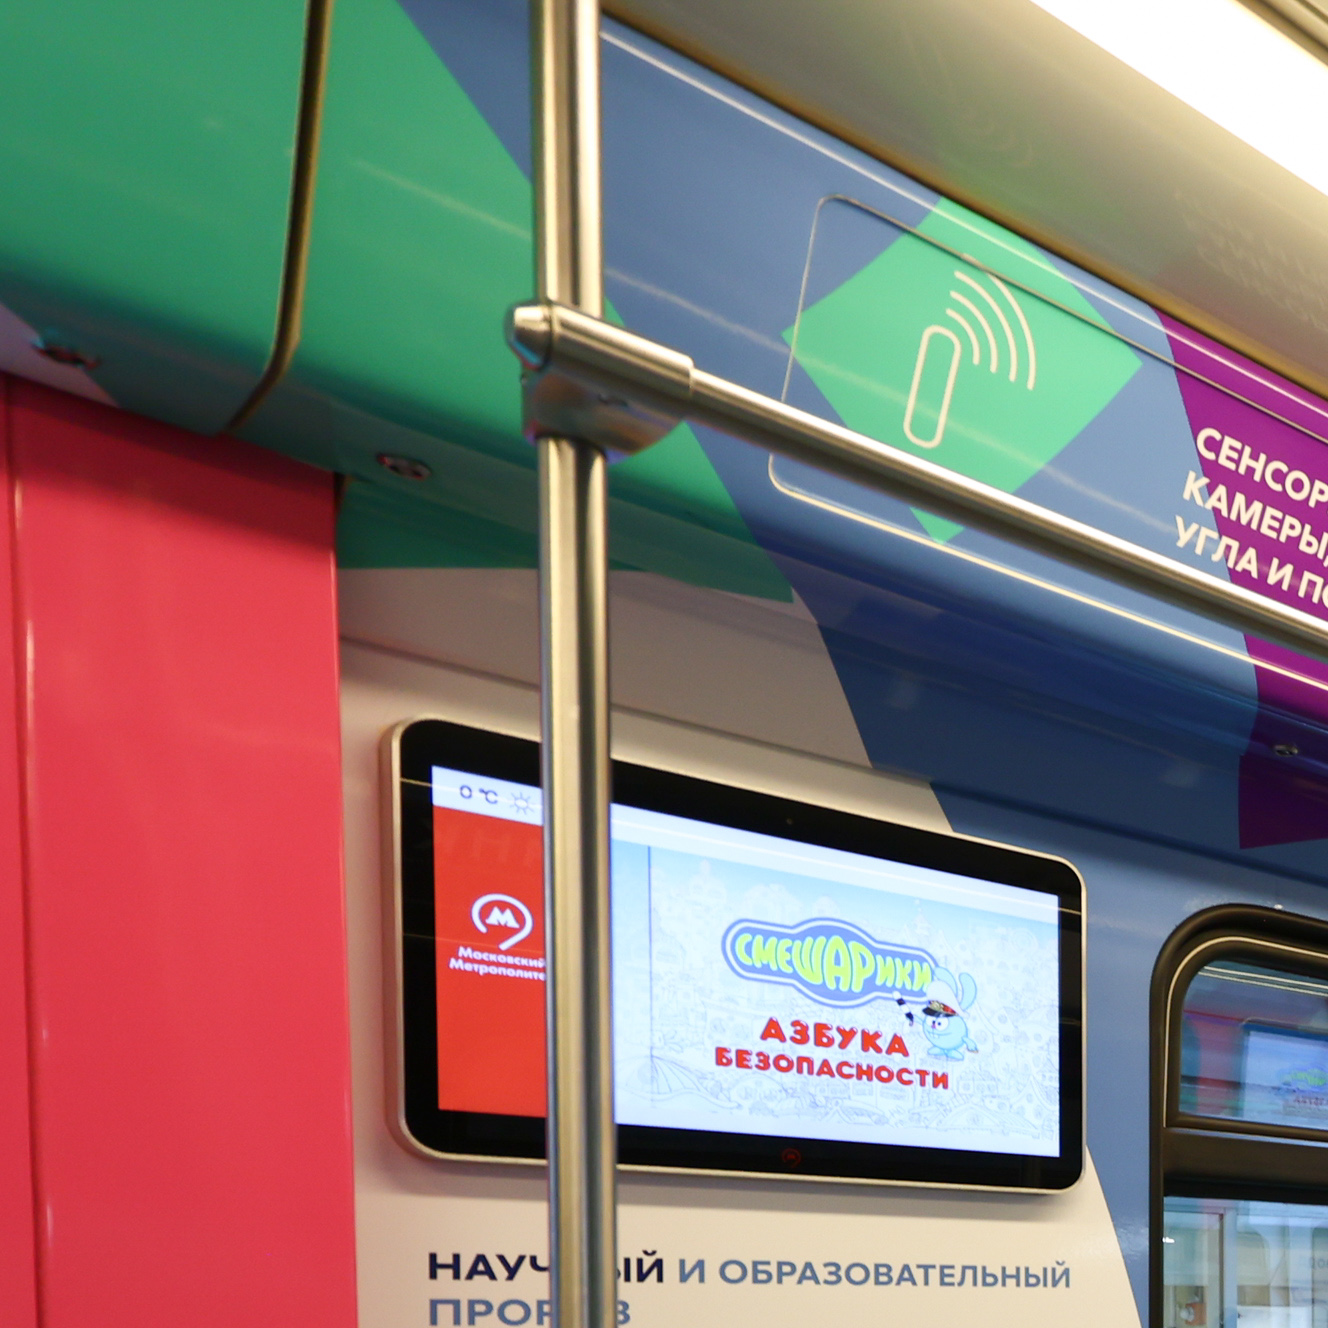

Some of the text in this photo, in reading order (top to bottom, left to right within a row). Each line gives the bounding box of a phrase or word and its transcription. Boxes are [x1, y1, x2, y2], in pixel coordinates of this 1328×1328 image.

[1174, 515, 1261, 580] УГЛА
[1265, 559, 1295, 591] И
[448, 957, 546, 982] Метрополите
[734, 932, 933, 994] СМЕШАРИКИ
[760, 1016, 910, 1058] АЗБУКА
[714, 1046, 950, 1090] БЕЗОПАСНОСТИ
[679, 1259, 706, 1284] И
[718, 1259, 1071, 1289] ОБРАЗОВАТЕЛЬНЫЙ
